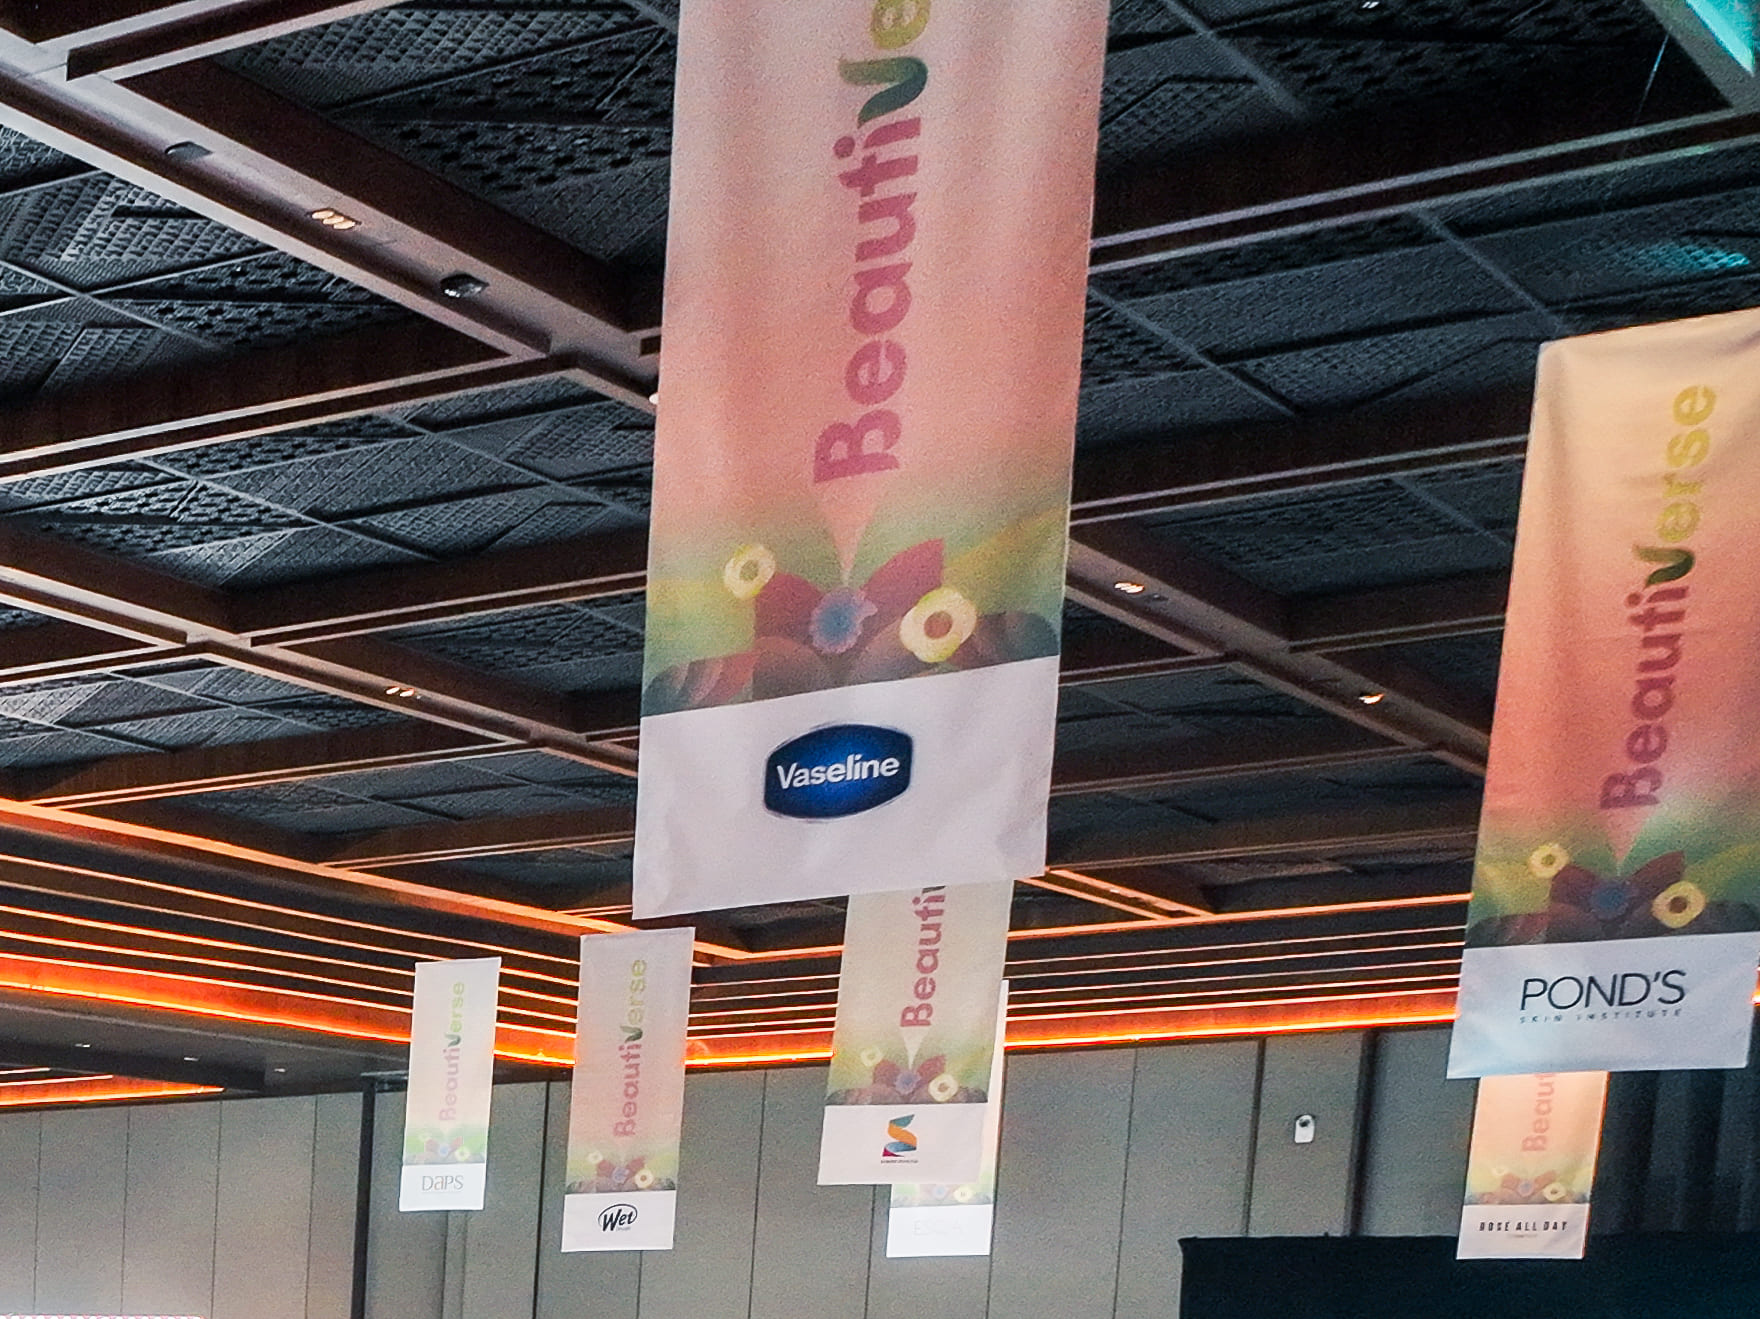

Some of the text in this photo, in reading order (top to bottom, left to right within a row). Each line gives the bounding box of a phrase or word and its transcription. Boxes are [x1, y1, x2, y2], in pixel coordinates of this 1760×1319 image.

[1599, 381, 1718, 809] BeautiVerse
[776, 750, 900, 792] Vaseline
[1518, 969, 1687, 1014] POND'S
[438, 979, 466, 1123] BeautiVerse
[613, 957, 648, 1138] BeautiVerse
[602, 1208, 634, 1232] Wet
